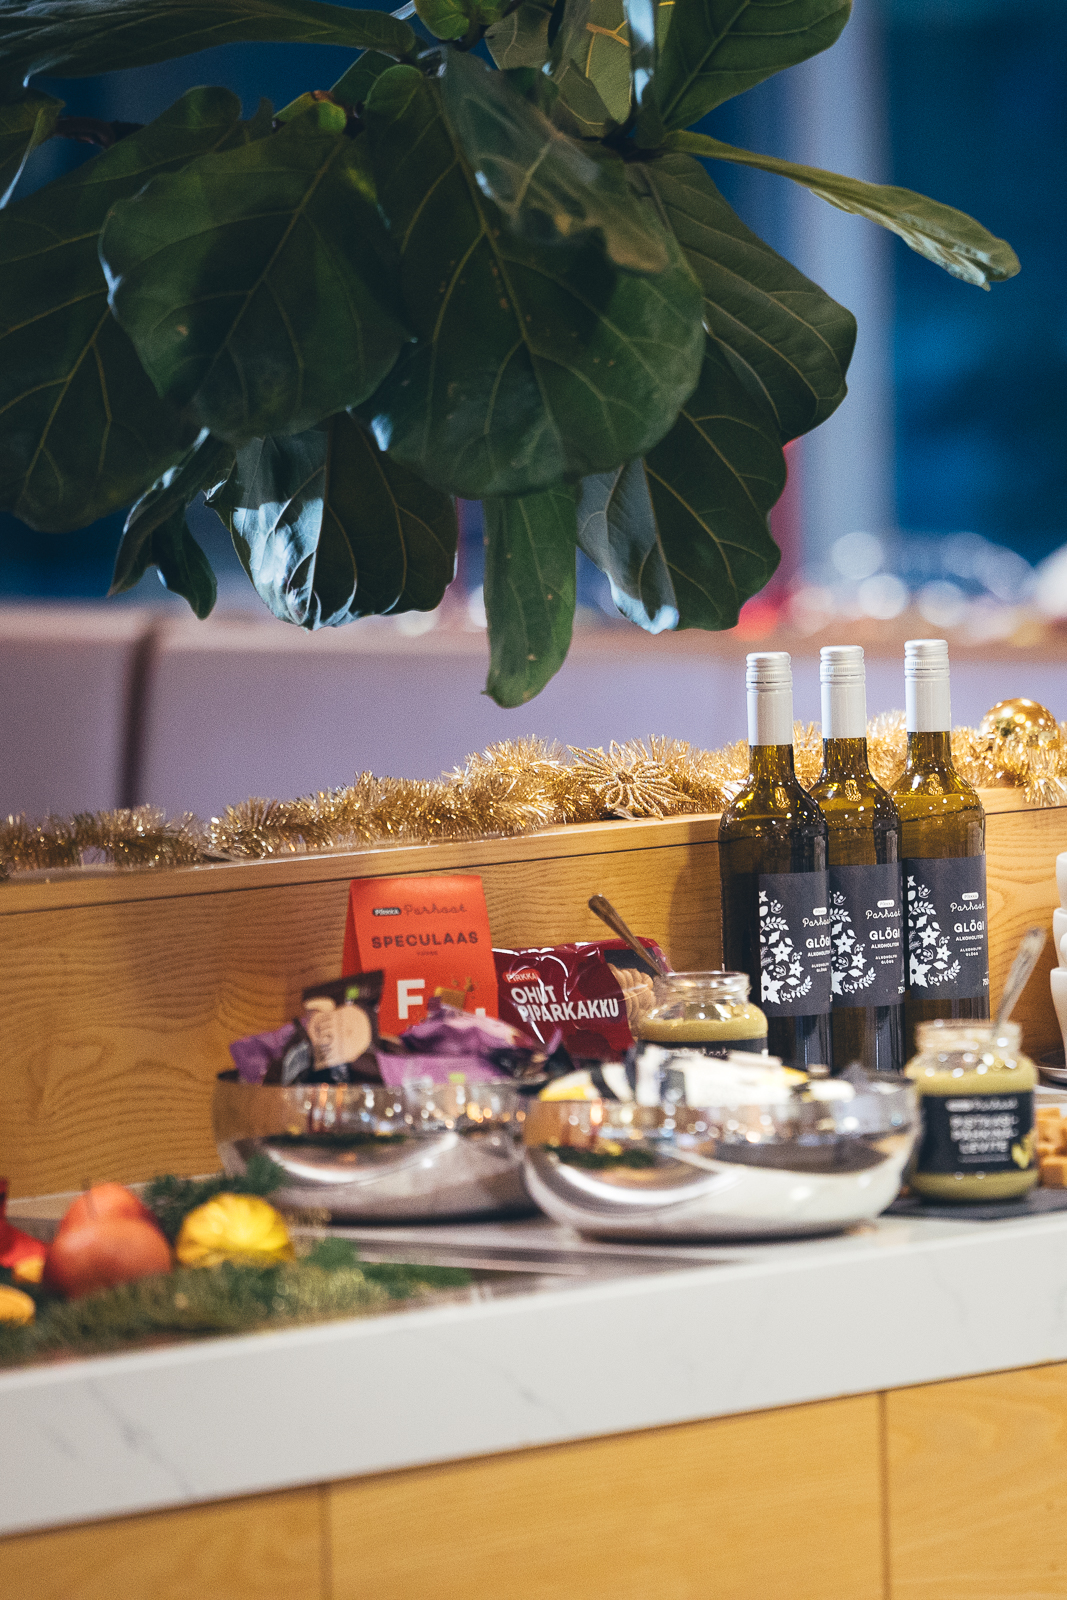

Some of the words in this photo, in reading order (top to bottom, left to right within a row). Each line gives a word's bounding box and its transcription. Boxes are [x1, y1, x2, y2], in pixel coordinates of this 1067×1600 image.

[403, 903, 468, 916] Parhaat
[865, 908, 901, 920] Parhaat
[950, 901, 985, 912] Parhaat
[869, 926, 901, 941] GLÖGI
[953, 919, 985, 933] GLÖGI
[371, 931, 479, 949] SPECULAAS
[805, 934, 831, 949] GLÖG
[510, 985, 558, 1005] OHUT
[517, 998, 620, 1023] PIPARKAKKU
